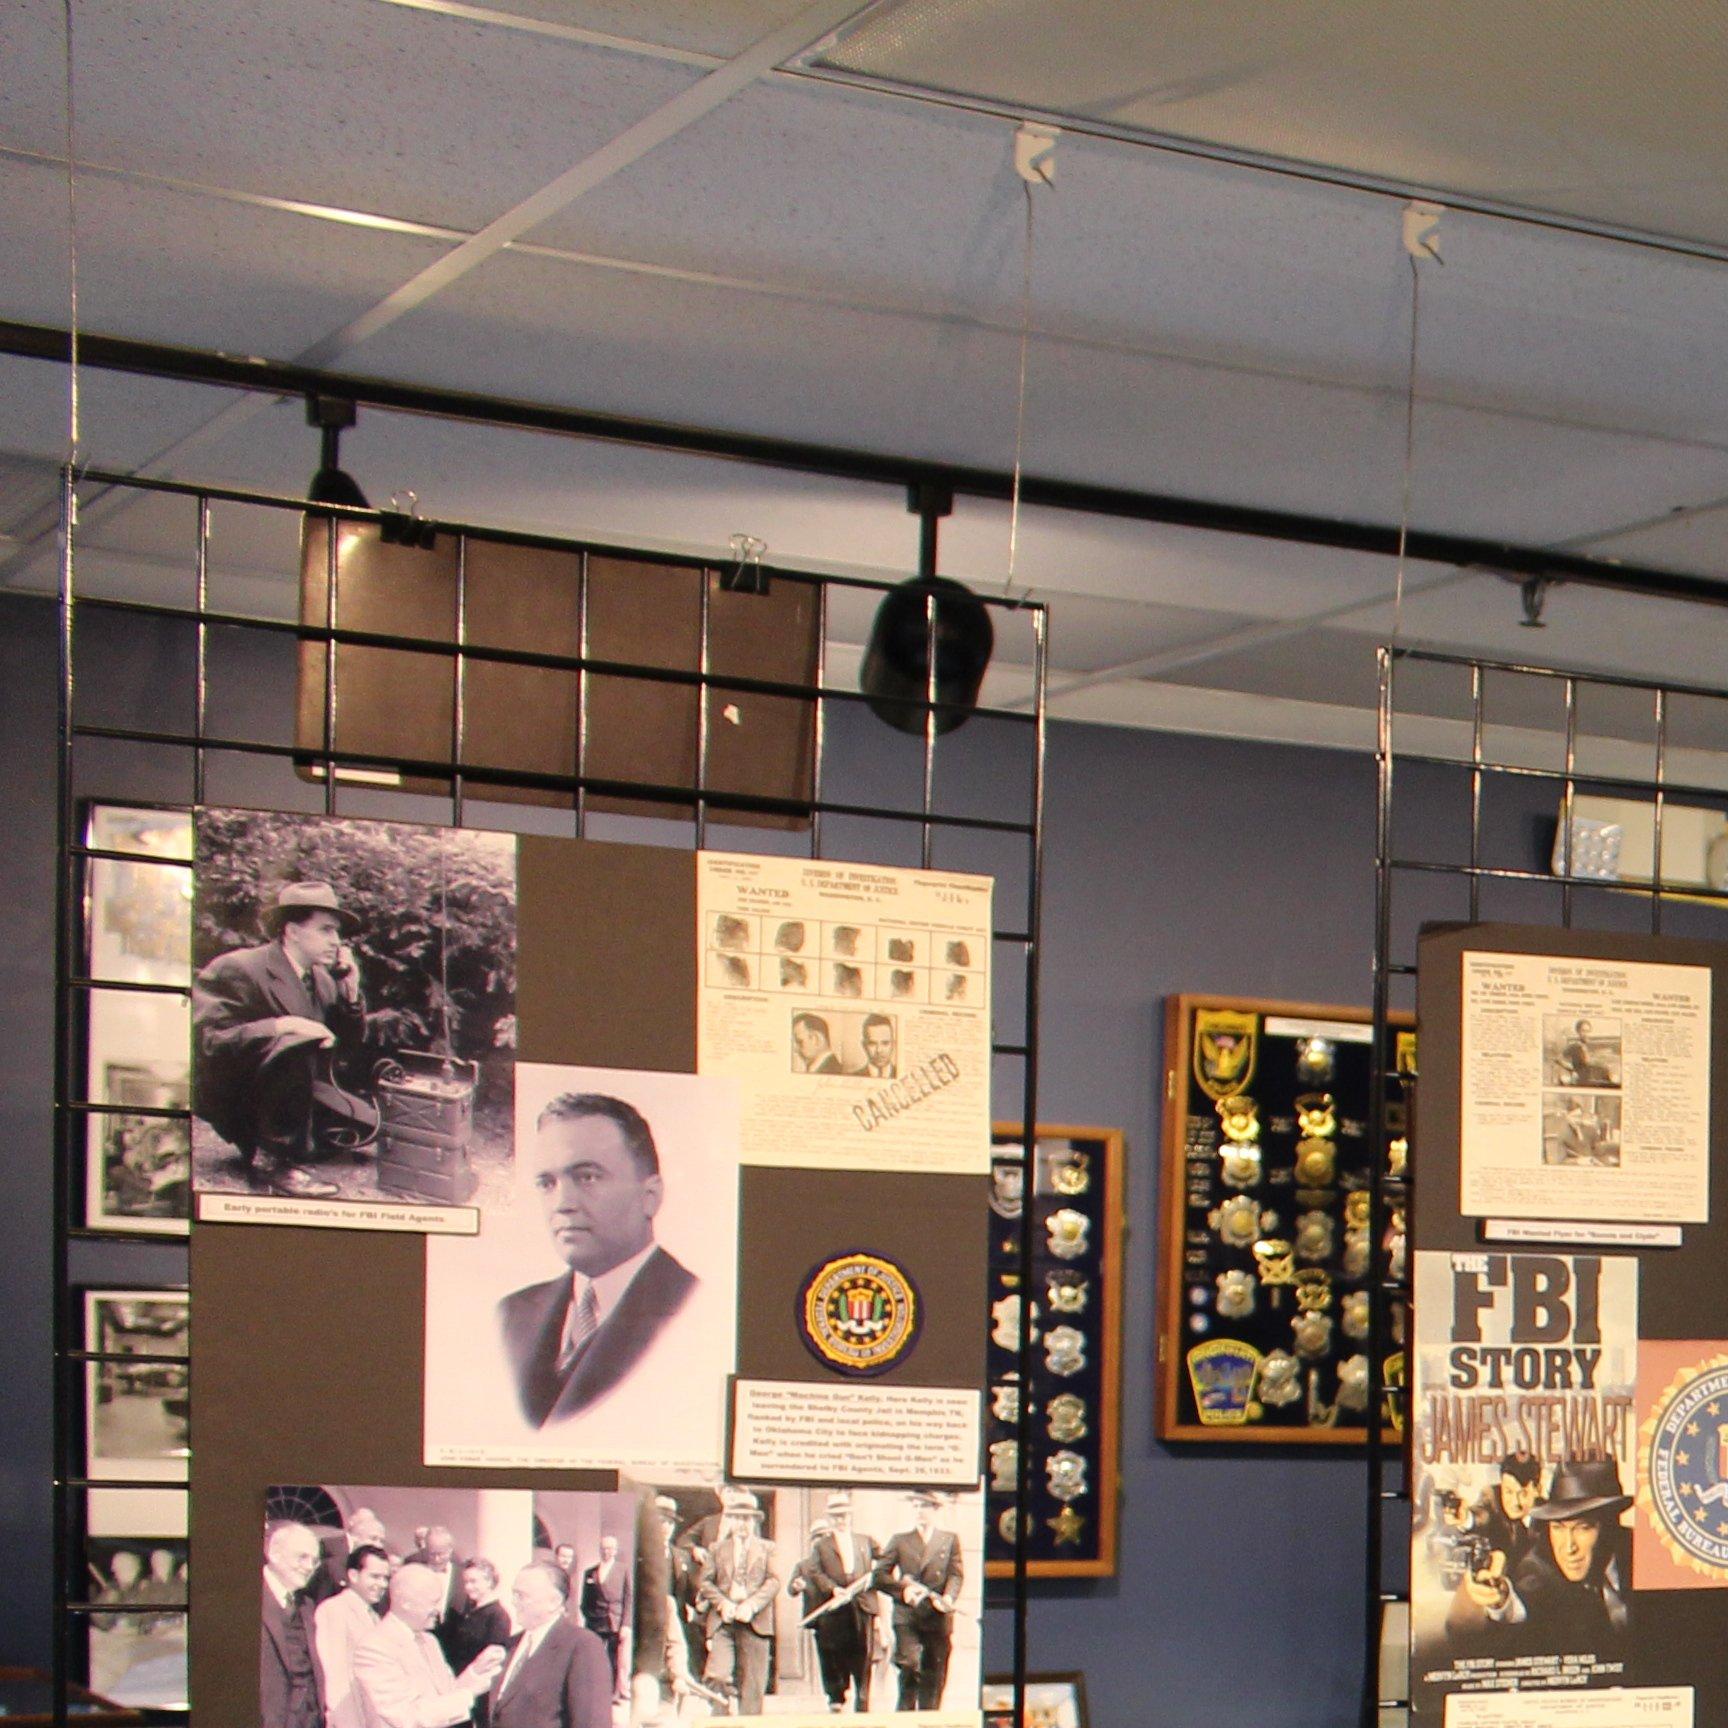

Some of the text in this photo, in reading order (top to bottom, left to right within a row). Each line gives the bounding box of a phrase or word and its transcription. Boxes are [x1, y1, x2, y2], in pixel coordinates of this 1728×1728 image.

[852, 1052, 961, 1132] CANCELLED
[1452, 1255, 1489, 1273] THE
[1452, 1255, 1602, 1344] FBI
[1450, 1347, 1601, 1390] STORY
[1421, 1390, 1633, 1464] JAMES STEWART
[1656, 1449, 1680, 1523] FEDERAL
